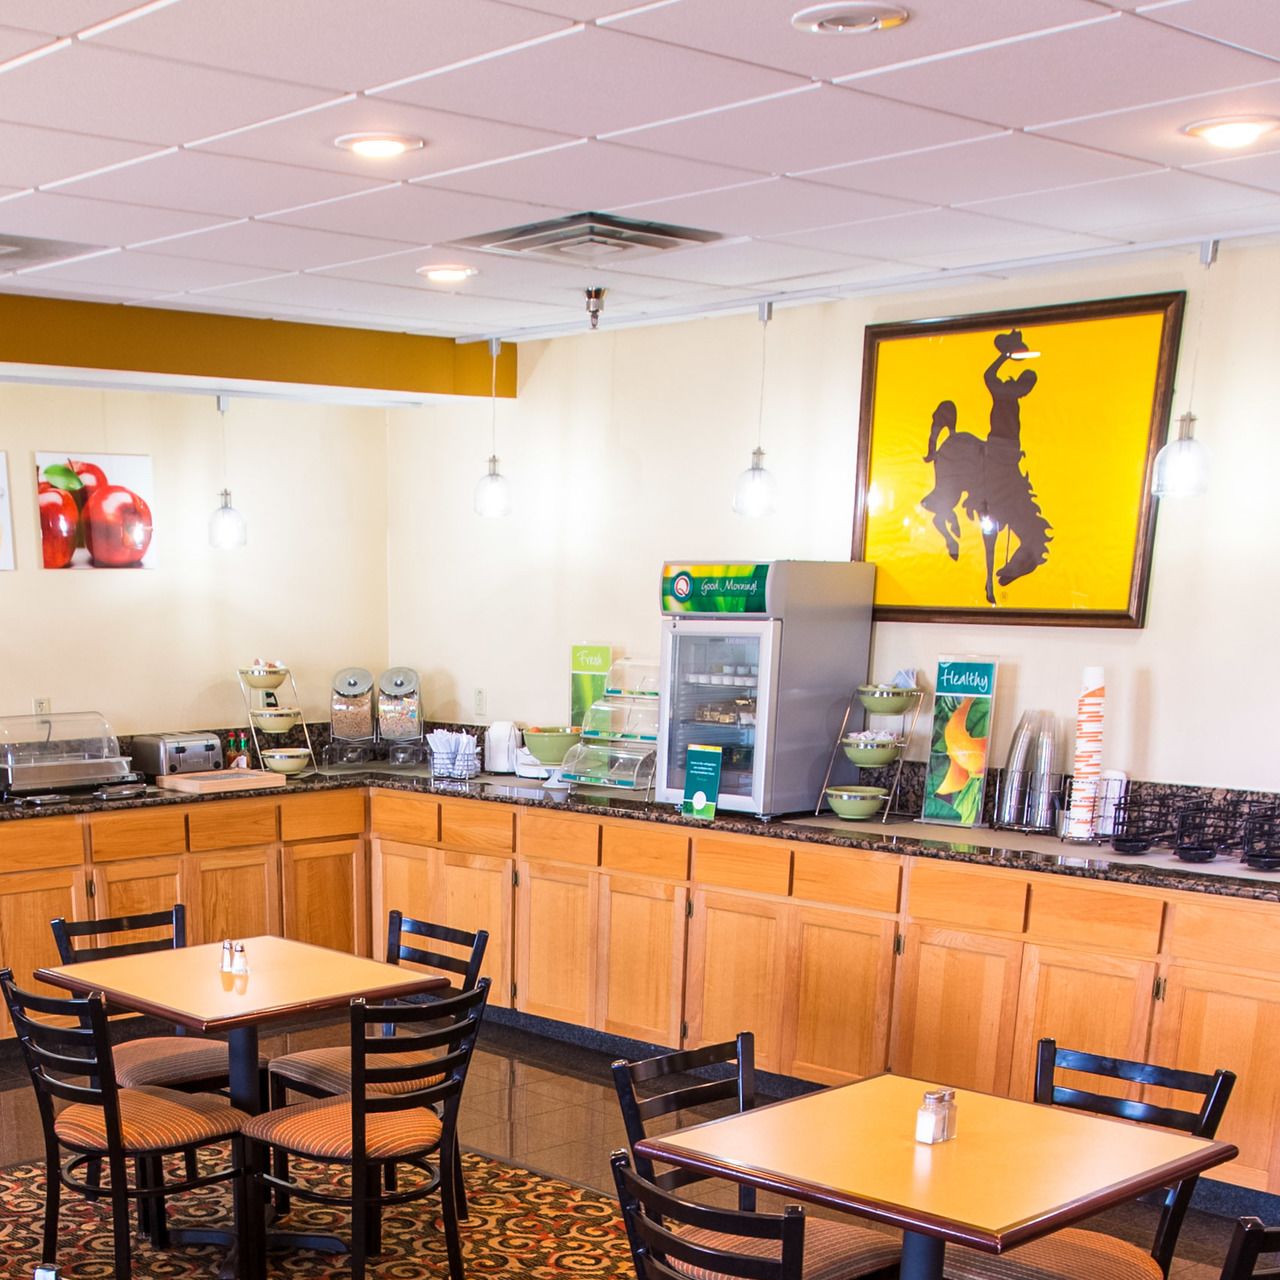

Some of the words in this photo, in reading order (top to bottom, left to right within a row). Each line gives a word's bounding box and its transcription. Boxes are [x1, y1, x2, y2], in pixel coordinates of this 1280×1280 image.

[701, 579, 719, 596] Good
[720, 578, 758, 596] Morning!
[940, 668, 988, 693] Healthy
